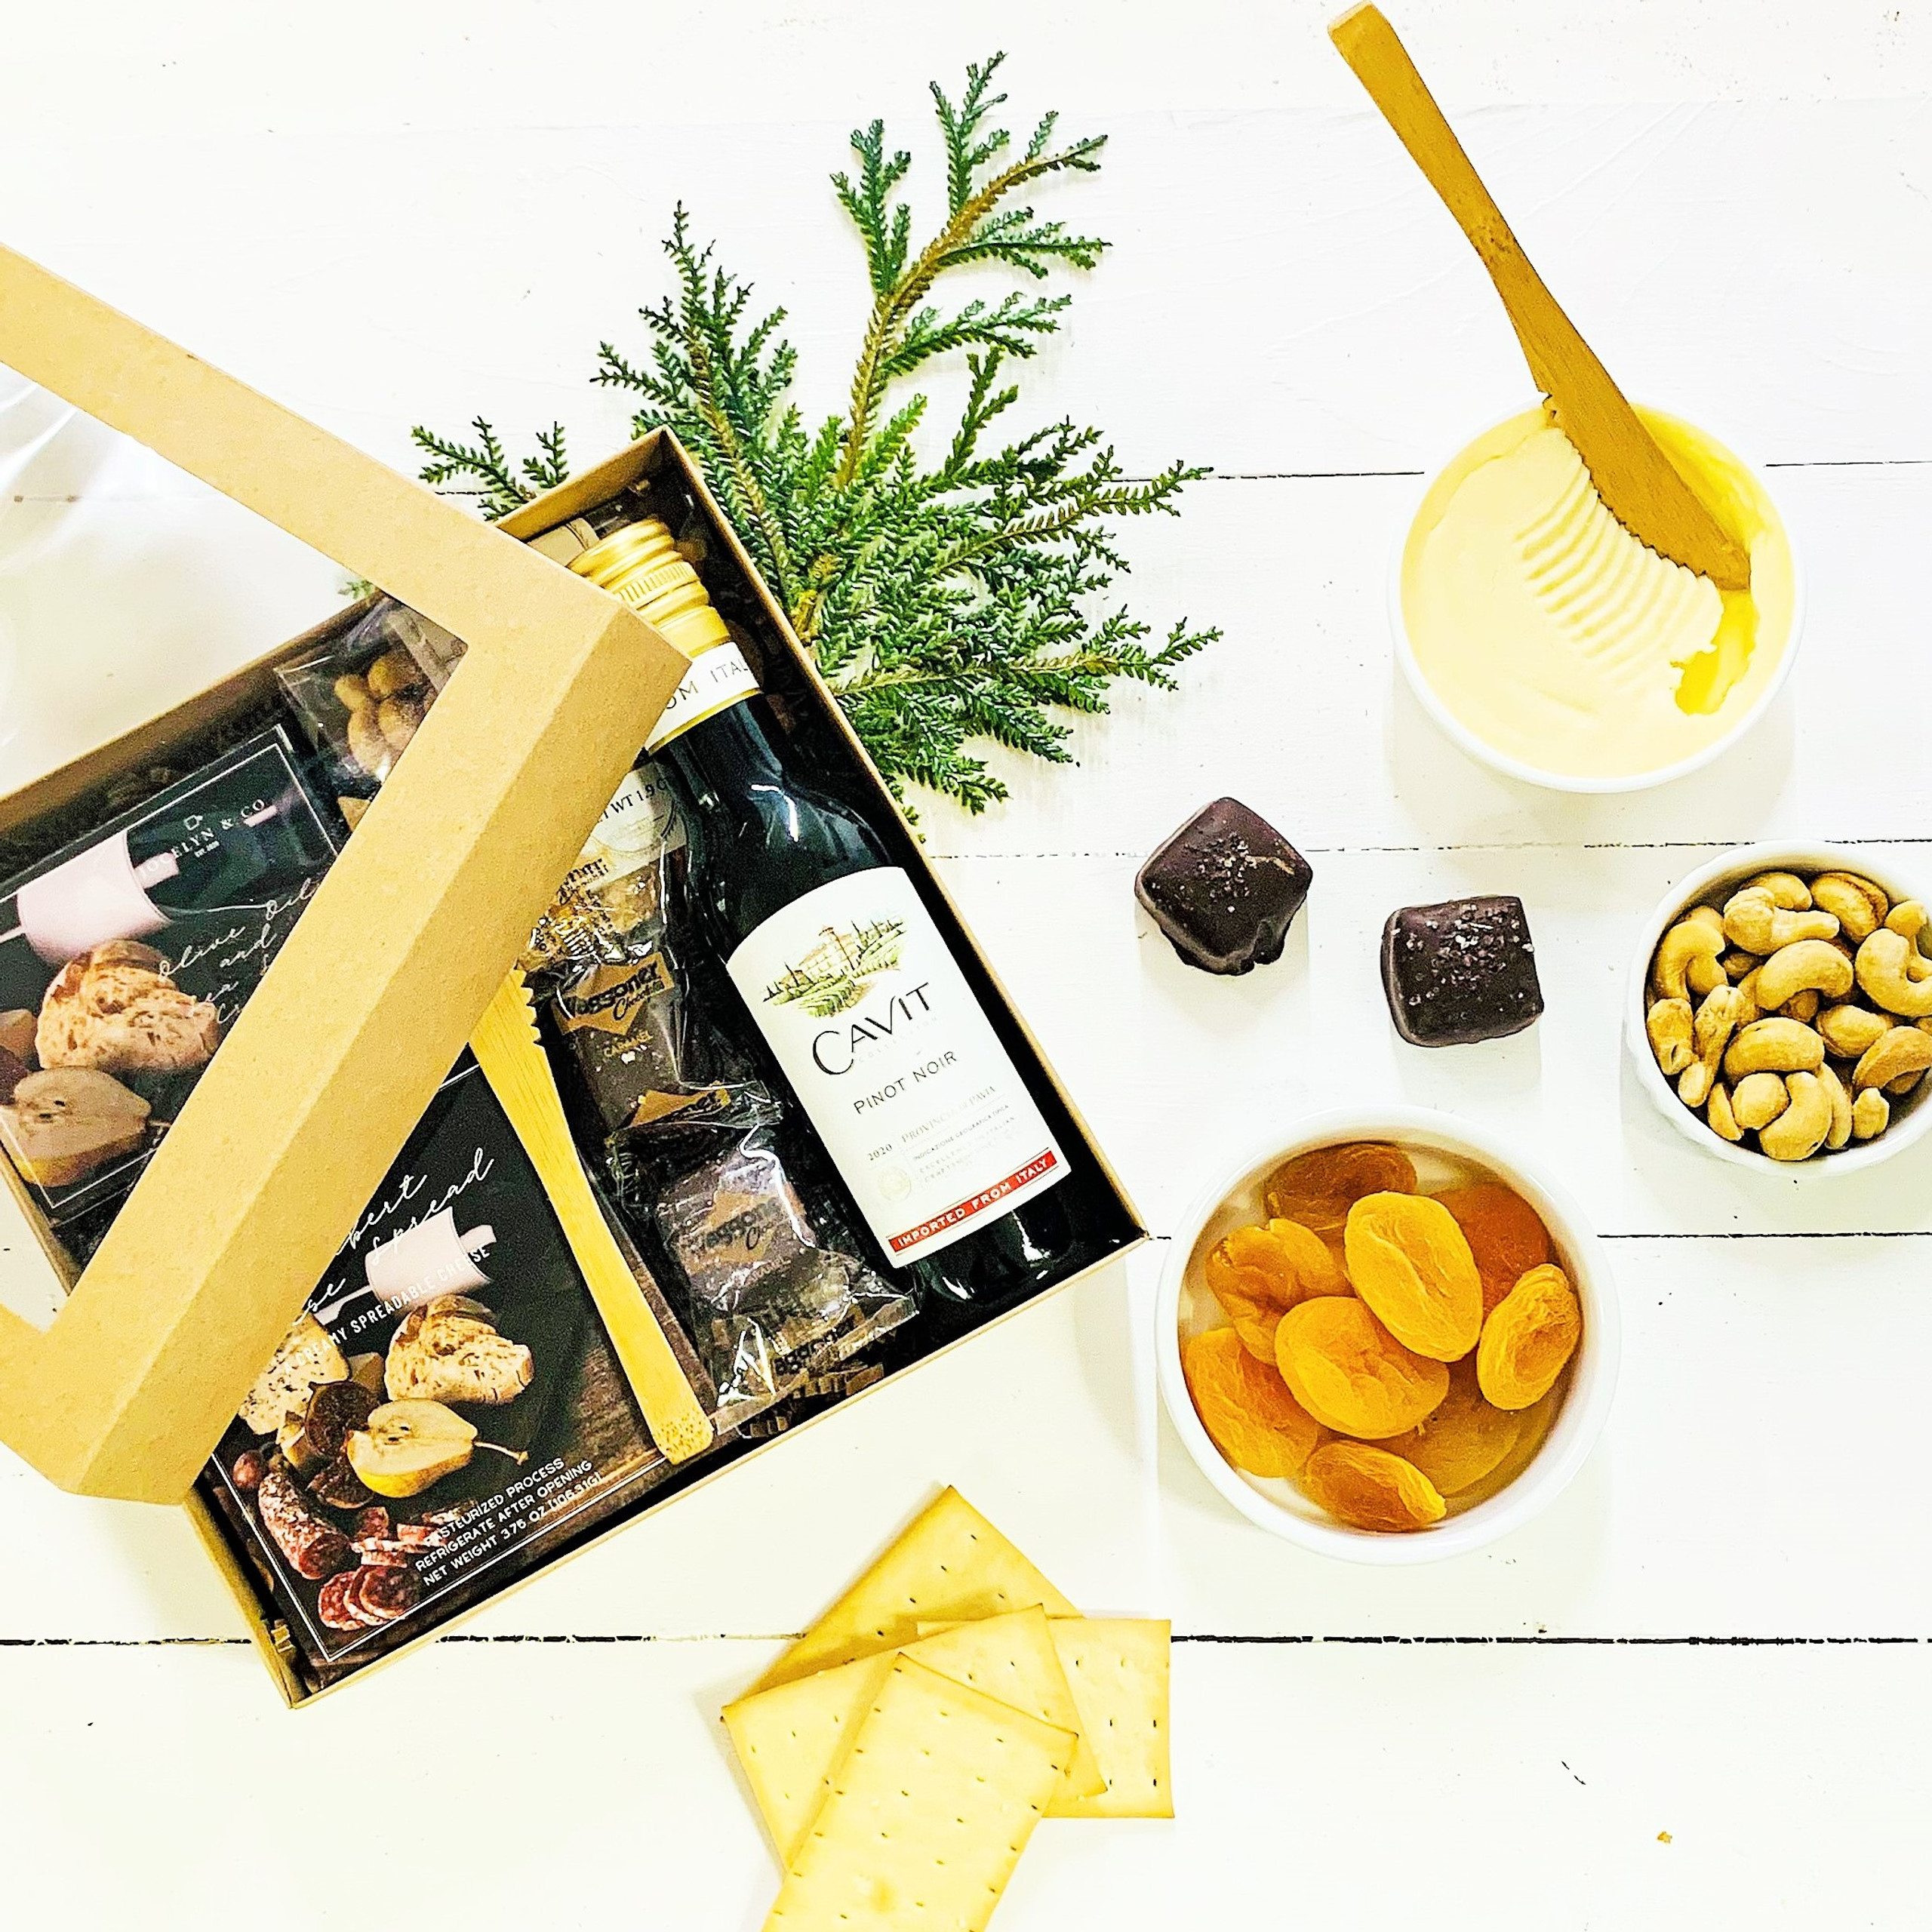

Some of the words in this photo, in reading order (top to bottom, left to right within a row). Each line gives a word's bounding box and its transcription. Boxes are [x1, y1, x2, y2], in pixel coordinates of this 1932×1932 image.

[666, 681, 699, 709] OM
[710, 659, 749, 683] ITAL
[220, 817, 235, 831] &
[610, 793, 633, 814] WT
[220, 923, 278, 968] and
[812, 982, 931, 1075] CAVIT
[854, 1078, 906, 1115] PINOT
[912, 1051, 957, 1082] NOIR
[868, 1143, 893, 1161] 2020
[897, 1208, 966, 1247] IMPORTED
[971, 1181, 1011, 1210] FROM
[1016, 1158, 1049, 1184] ITALY
[295, 1327, 348, 1364] CREAMY
[350, 1276, 436, 1334] SPREADABLE
[437, 1245, 491, 1282] CHEESE
[414, 1518, 496, 1573] REFRIGERATE
[498, 1494, 536, 1522] AFTER
[536, 1460, 592, 1498] OPENING
[423, 1494, 504, 1548] PASTEURIZED
[505, 1457, 565, 1498] PROCESS
[423, 1564, 448, 1586] NET
[450, 1534, 498, 1570] WEIGHT
[528, 1506, 547, 1523] OZ
